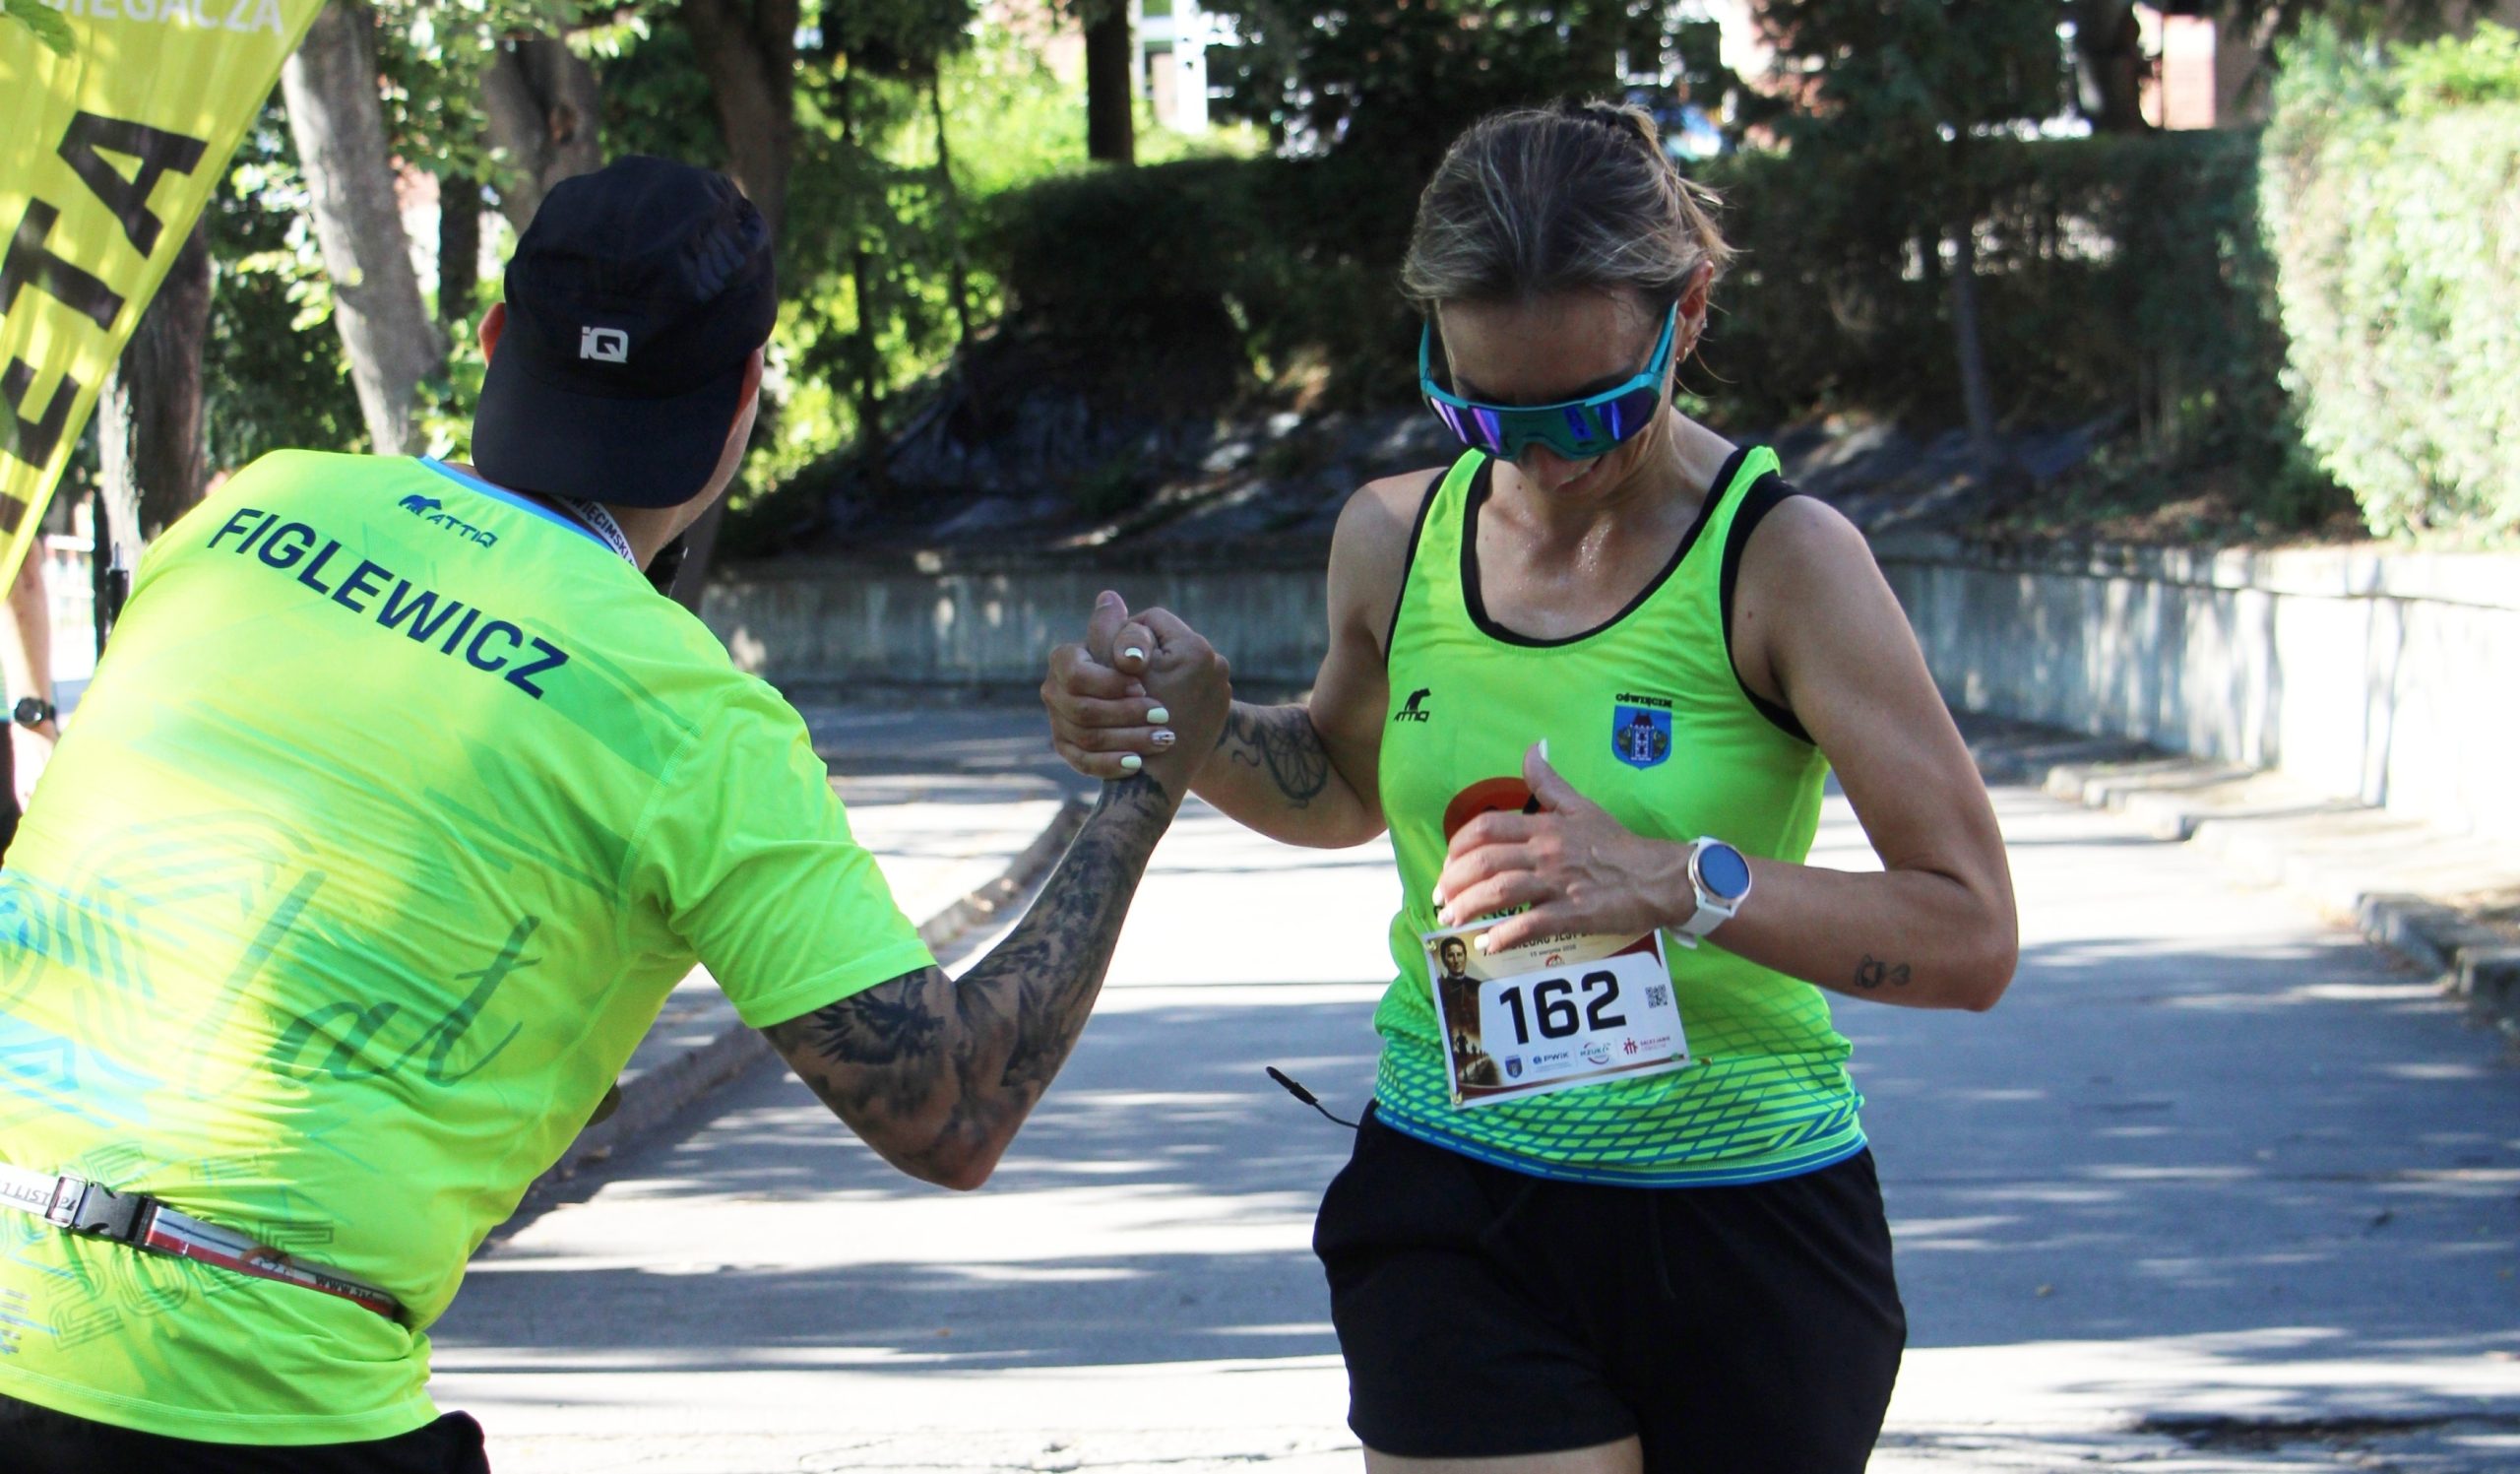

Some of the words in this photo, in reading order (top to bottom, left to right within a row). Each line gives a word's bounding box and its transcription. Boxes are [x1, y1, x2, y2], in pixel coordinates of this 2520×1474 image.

[41, 0, 284, 35] IEGACZA
[0, 110, 209, 537] ETA
[425, 514, 499, 549] ATTIQ
[207, 507, 570, 700] FIGLEWICZ
[1498, 970, 1627, 1046] 162
